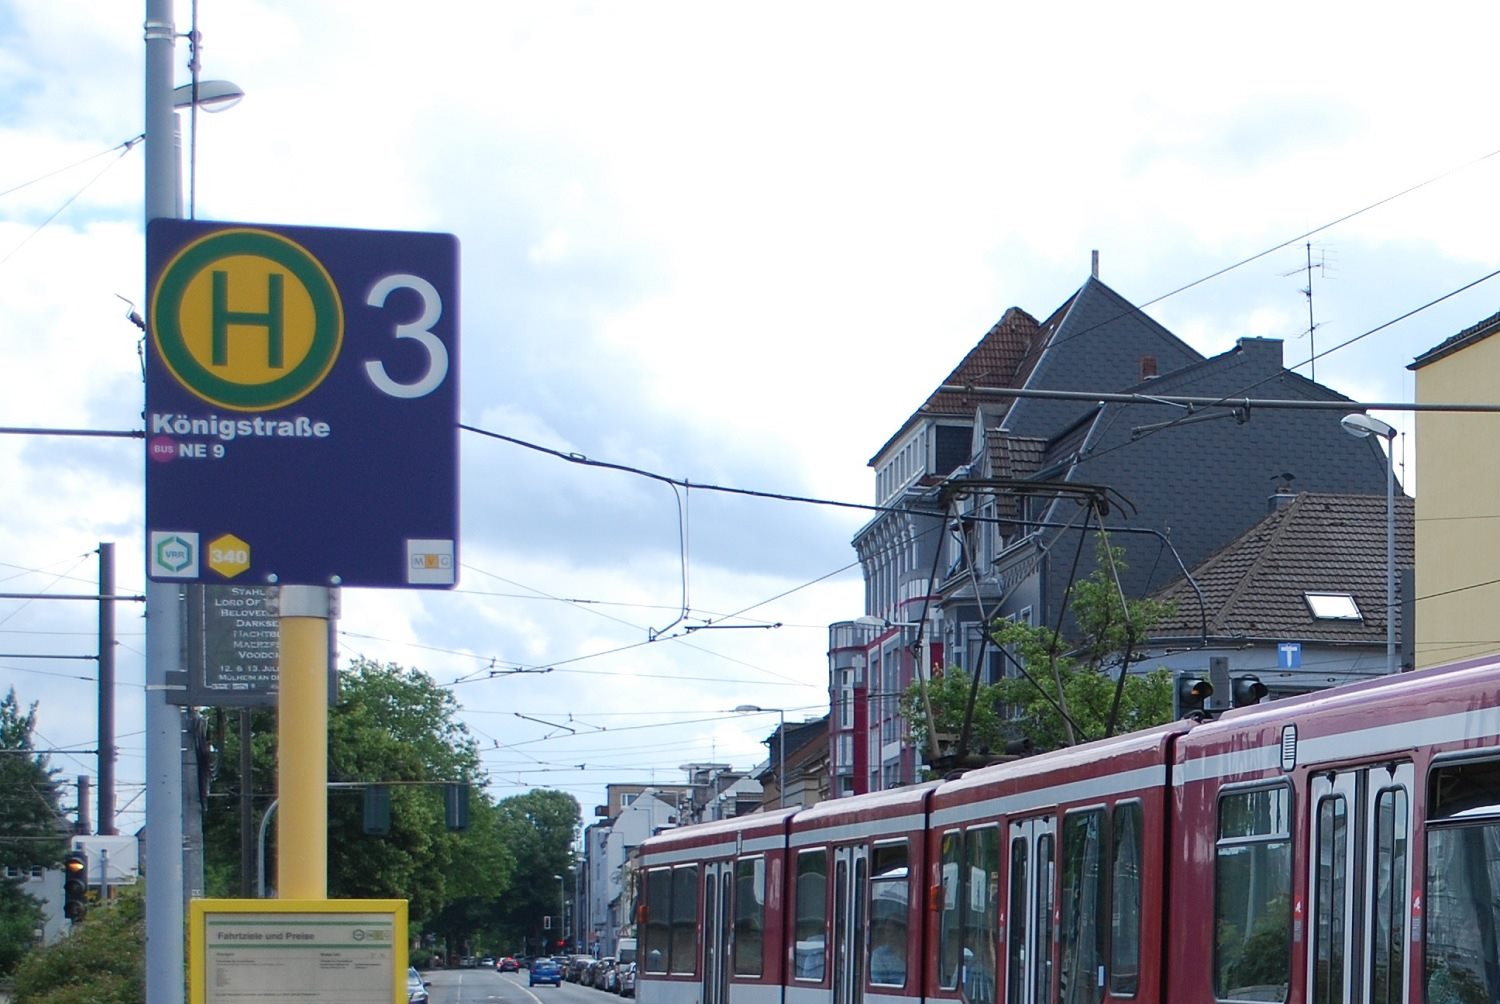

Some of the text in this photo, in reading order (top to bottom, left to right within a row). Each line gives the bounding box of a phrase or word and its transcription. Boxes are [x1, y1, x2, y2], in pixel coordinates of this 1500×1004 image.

[211, 270, 284, 368] H
[365, 273, 449, 399] 3
[152, 413, 331, 440] Königstraße
[153, 443, 226, 458] BUS NE 9
[165, 550, 185, 559] VRR
[212, 549, 249, 564] 340
[217, 931, 316, 941] Fahrtziele und Preise
